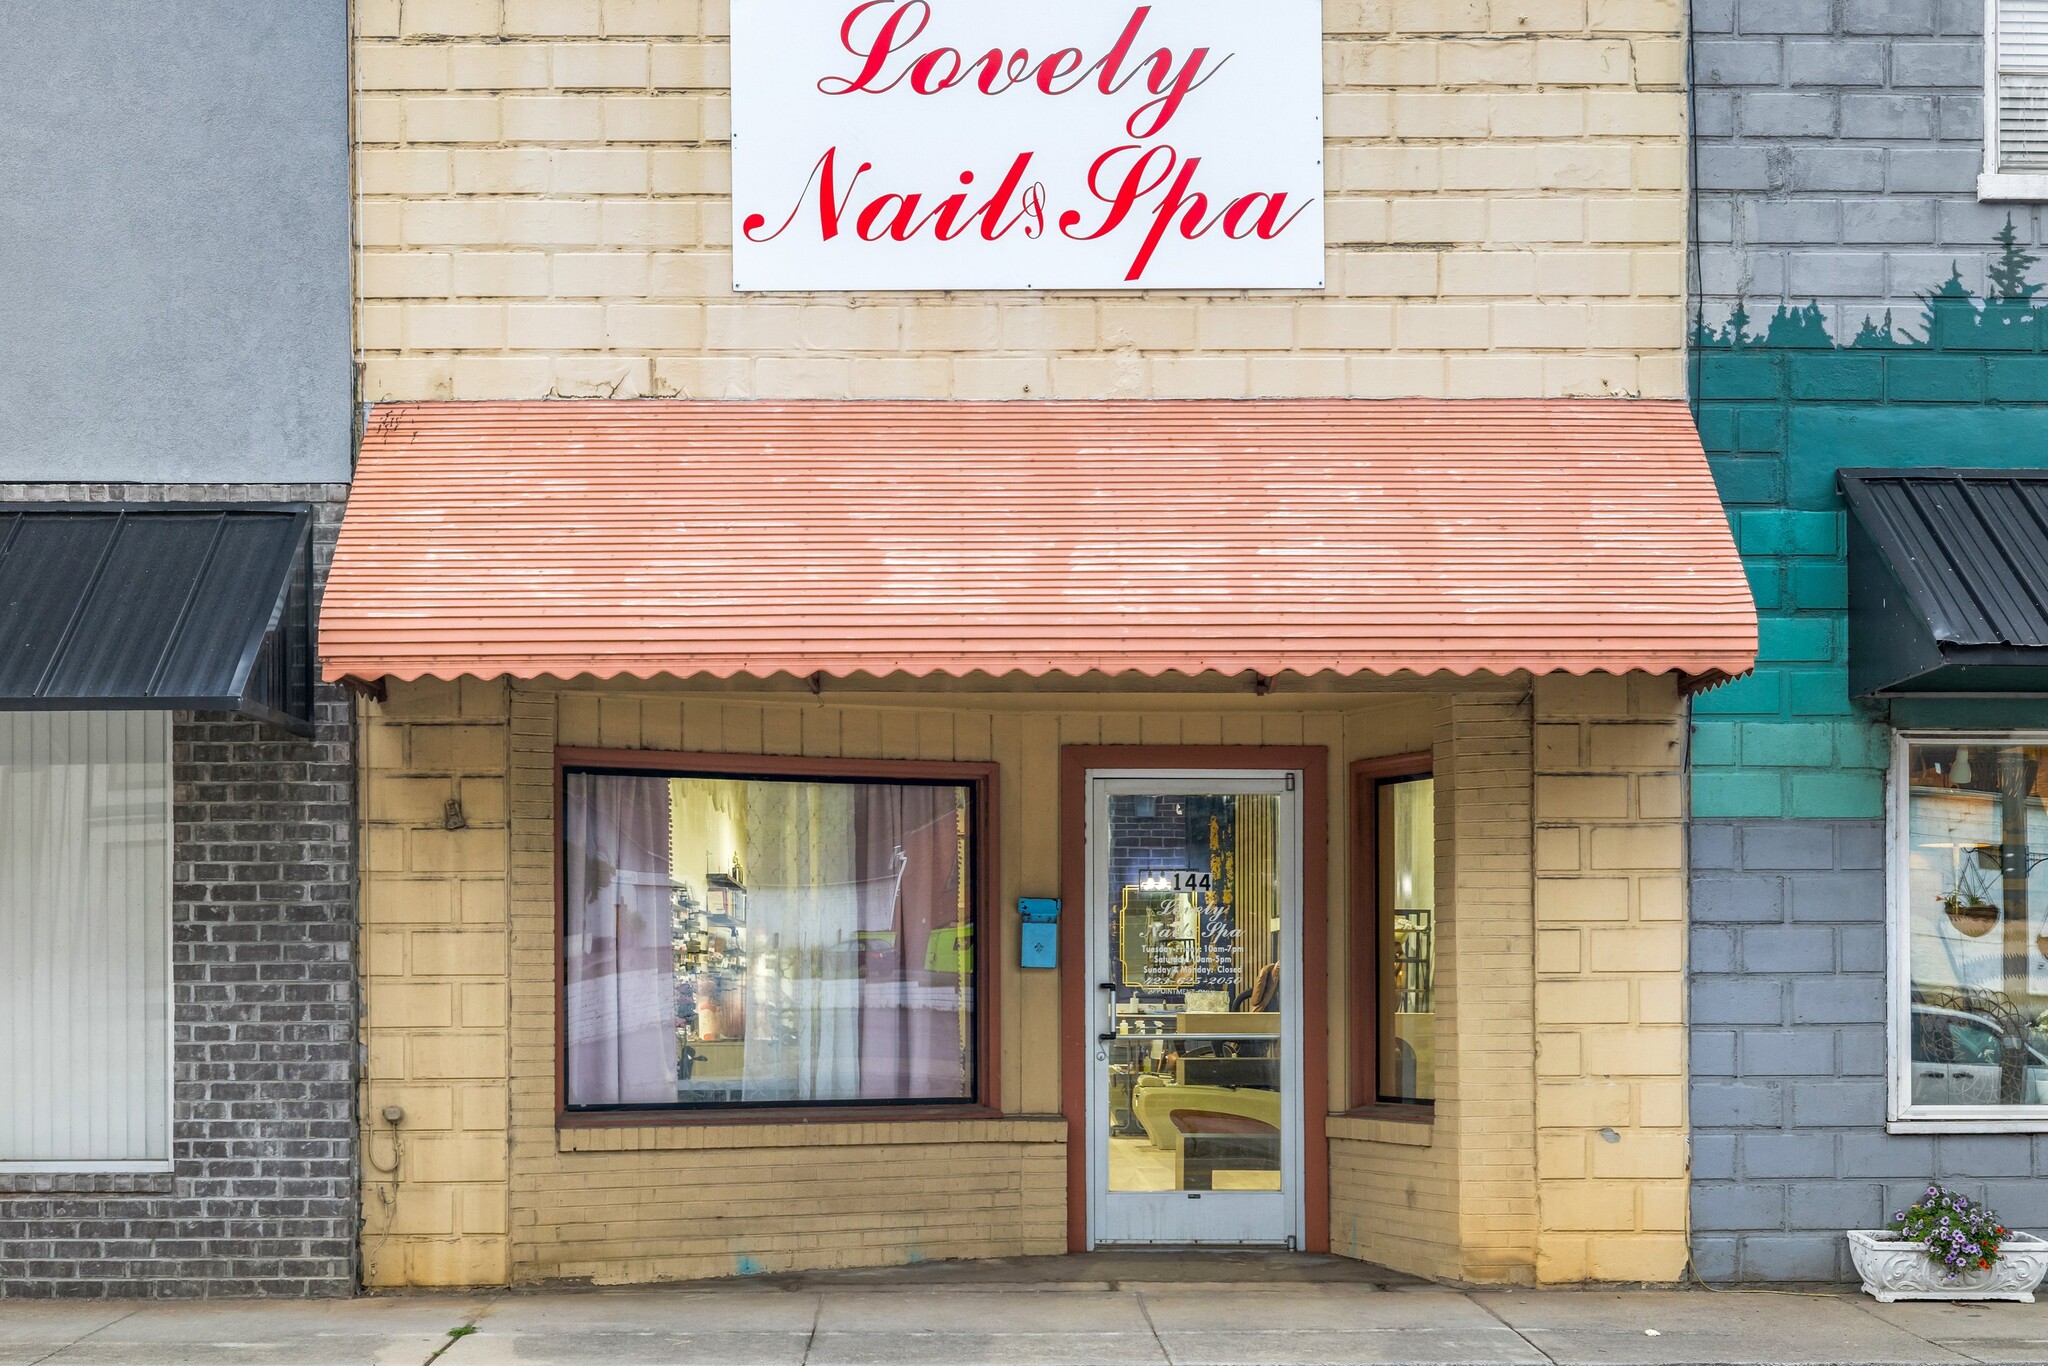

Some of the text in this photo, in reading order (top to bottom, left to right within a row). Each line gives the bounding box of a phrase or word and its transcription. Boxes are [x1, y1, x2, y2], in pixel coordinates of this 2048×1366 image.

[816, 0, 1237, 139] Lovely
[1058, 144, 1315, 282] Spa
[1173, 873, 1211, 891] 144
[1201, 922, 1246, 944] Spa
[1204, 945, 1244, 956] 10am-7pm
[1143, 966, 1171, 976] Sunday
[1217, 966, 1243, 974] Closed
